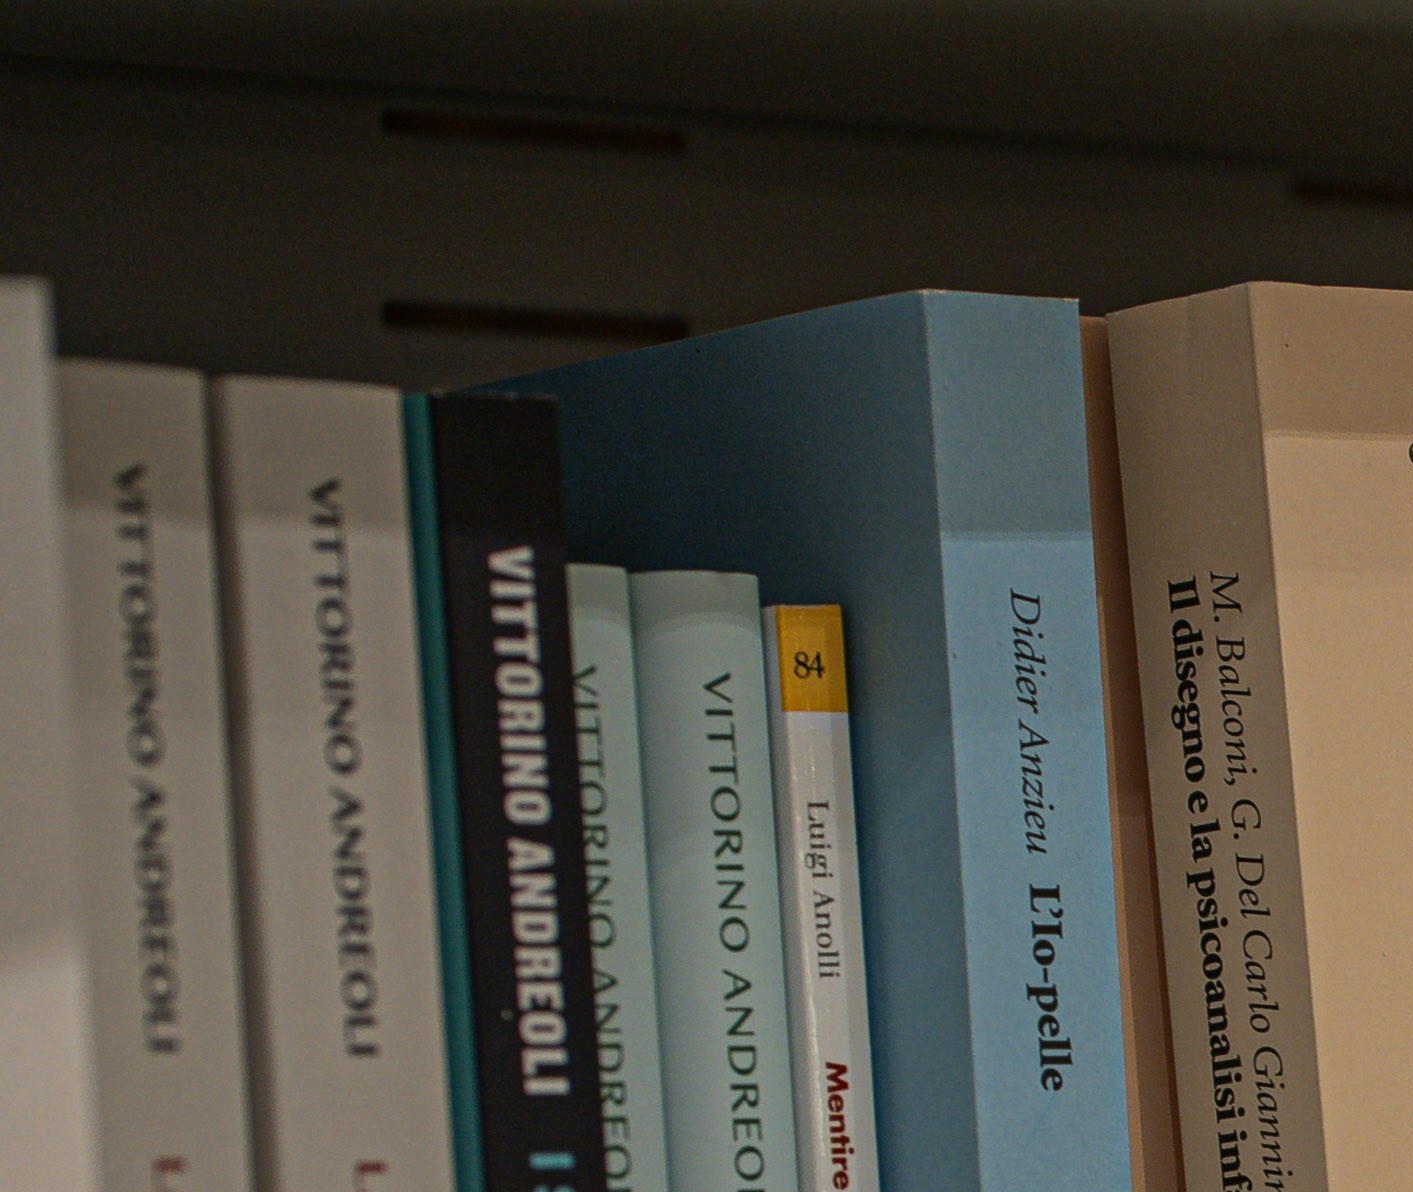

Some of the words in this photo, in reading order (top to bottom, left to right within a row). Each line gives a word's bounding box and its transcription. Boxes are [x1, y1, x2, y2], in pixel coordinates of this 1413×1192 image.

[113, 465, 168, 777] VITTORINO
[305, 478, 361, 773] VITTORINO
[1009, 587, 1041, 714] Didier
[1168, 577, 1201, 612] Il
[1209, 571, 1242, 622] M.
[488, 545, 552, 824] VITTORINO
[794, 651, 825, 679] 84
[1169, 619, 1208, 783] disegno
[1214, 638, 1256, 787] Balconi,
[572, 666, 616, 950] VITTORINO
[702, 673, 749, 953] VITTORINO
[805, 800, 830, 879] Luigi
[1010, 719, 1049, 854] Anzieu
[1188, 791, 1209, 814] e
[1190, 821, 1217, 862] la
[1229, 798, 1262, 841] G.
[131, 783, 179, 1054] ANDREOLI
[330, 790, 379, 1058] ANDREOLI
[812, 889, 841, 979] Anolli
[1235, 854, 1271, 918] Del
[506, 836, 570, 1097] ANDREOLI
[1187, 871, 1246, 1122] psicoanalisi
[1241, 929, 1279, 1034] Carlo
[529, 1150, 574, 1169] I
[825, 1061, 853, 1191] Mentire
